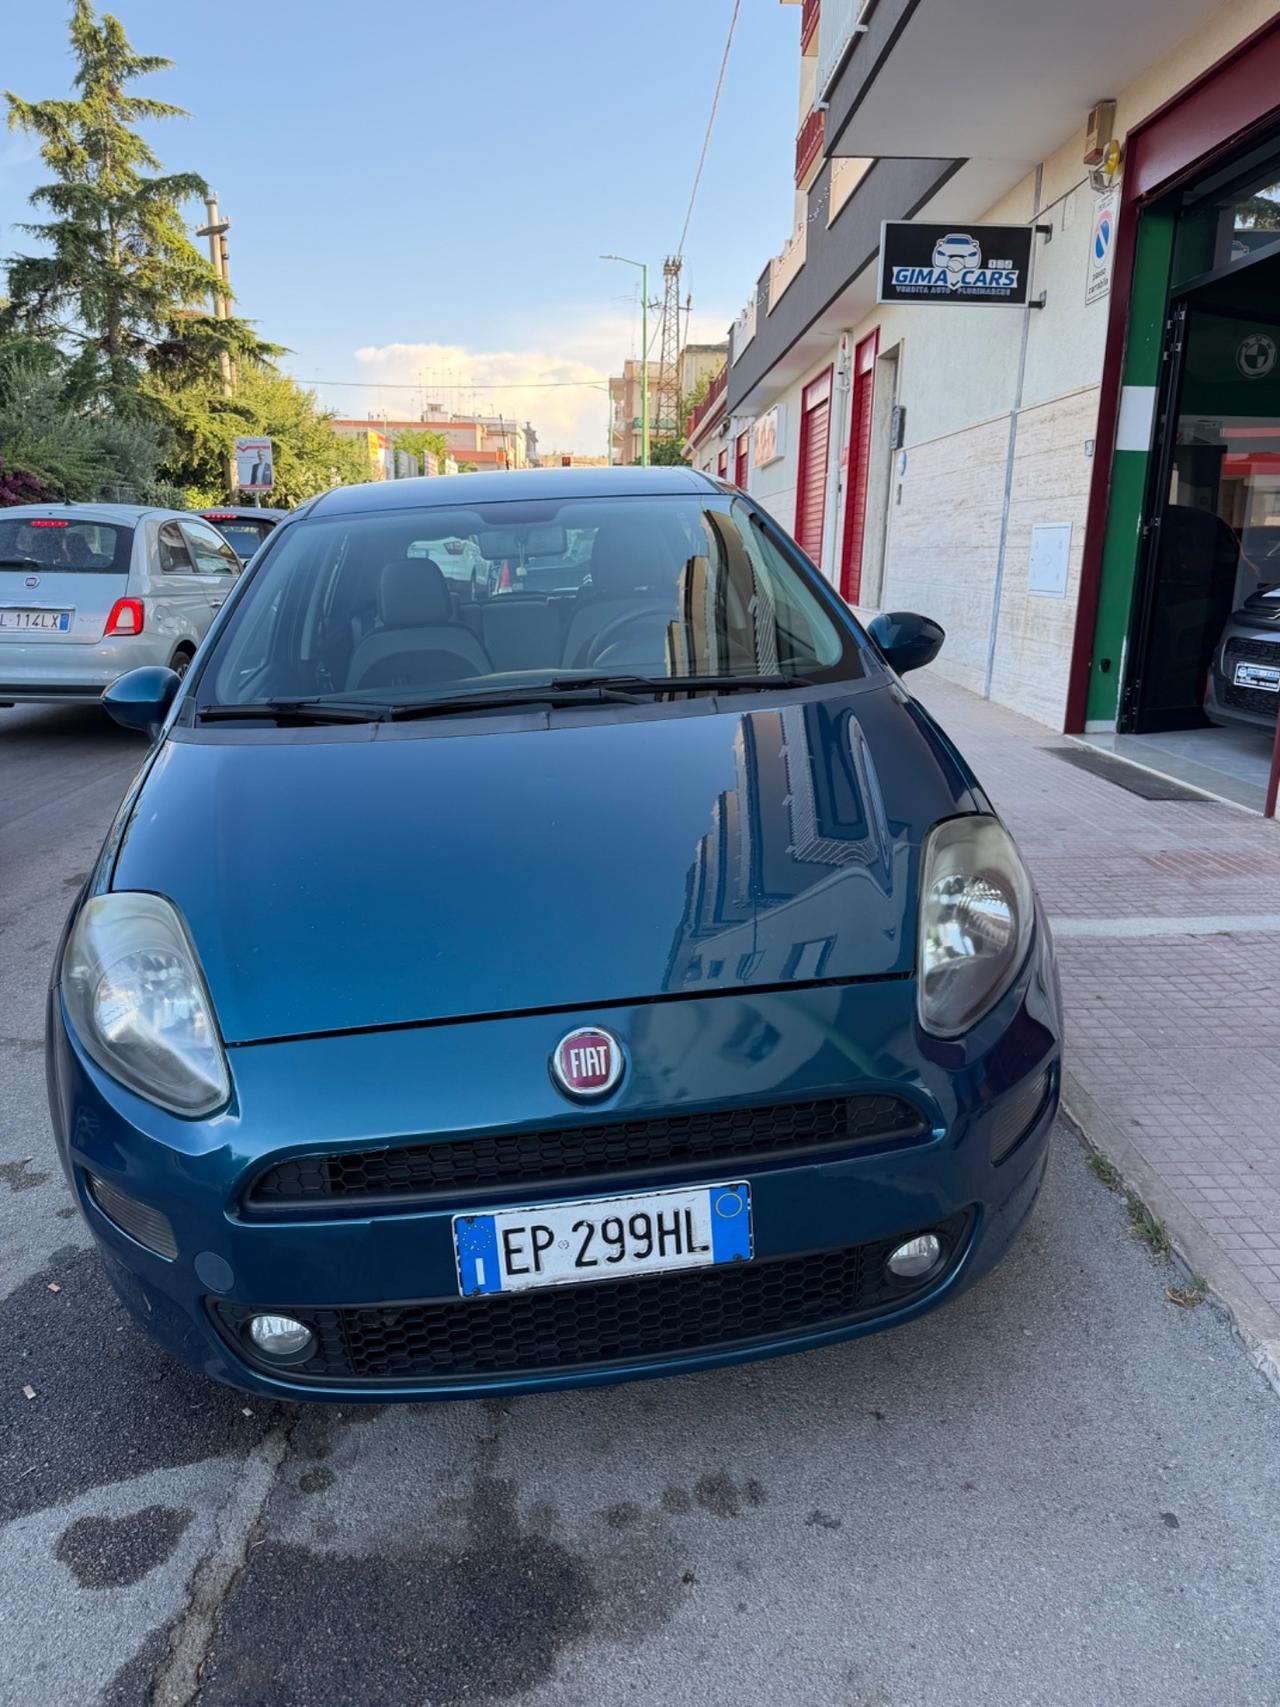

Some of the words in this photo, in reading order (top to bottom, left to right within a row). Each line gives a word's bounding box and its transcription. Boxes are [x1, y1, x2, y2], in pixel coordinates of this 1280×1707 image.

[895, 268, 948, 285] GIMA
[960, 270, 1017, 286] CARS
[16, 613, 60, 628] 114LX
[570, 1046, 608, 1078] FIAT
[502, 1225, 554, 1276] EP
[572, 1207, 710, 1268] 299HL
